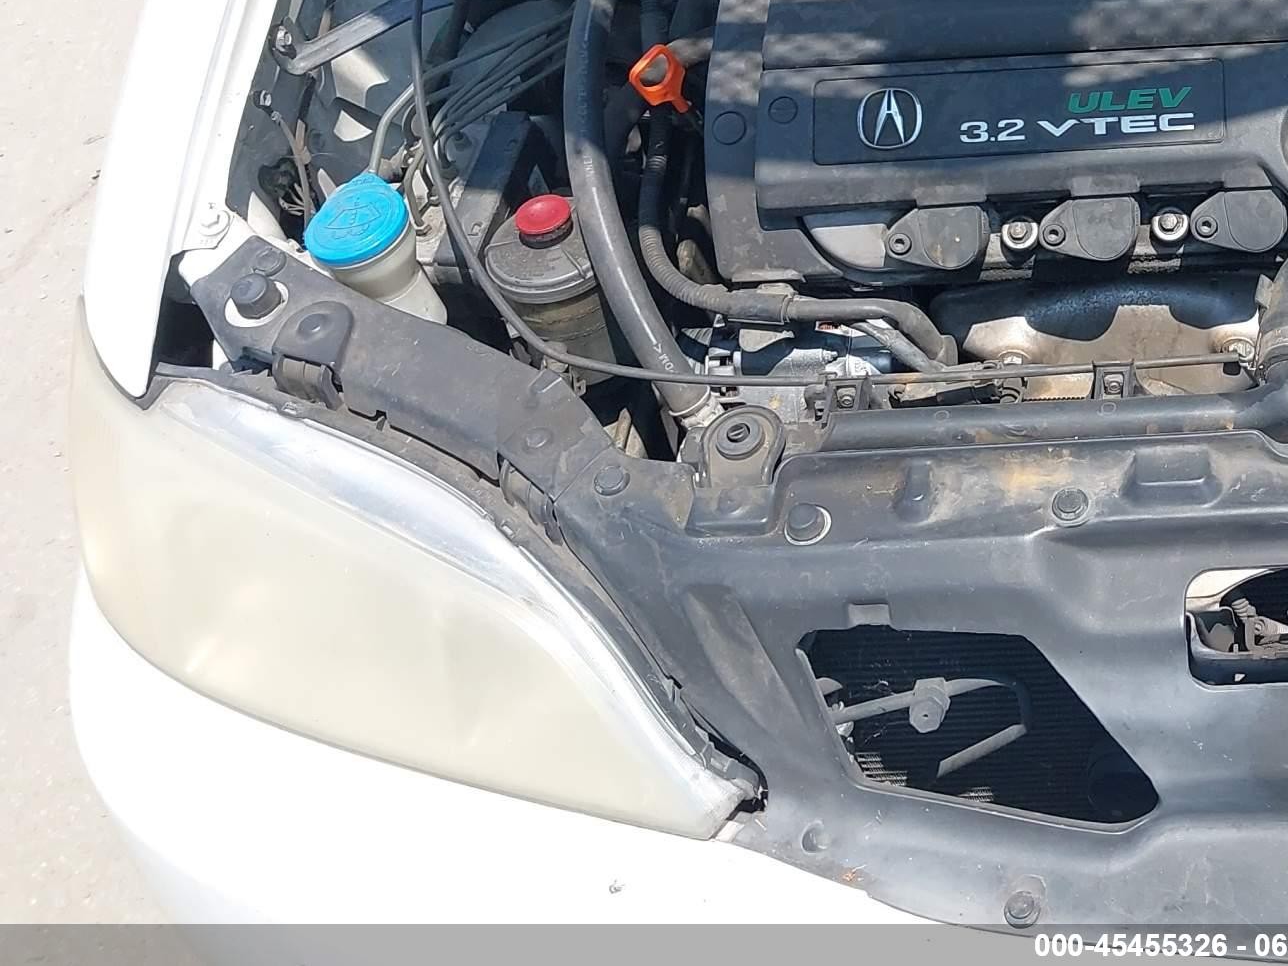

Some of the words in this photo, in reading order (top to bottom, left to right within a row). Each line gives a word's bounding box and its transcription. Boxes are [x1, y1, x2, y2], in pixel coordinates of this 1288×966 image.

[1067, 86, 1192, 113] ULEV
[959, 119, 1026, 143] 3.2
[1036, 112, 1195, 137] VTEC
